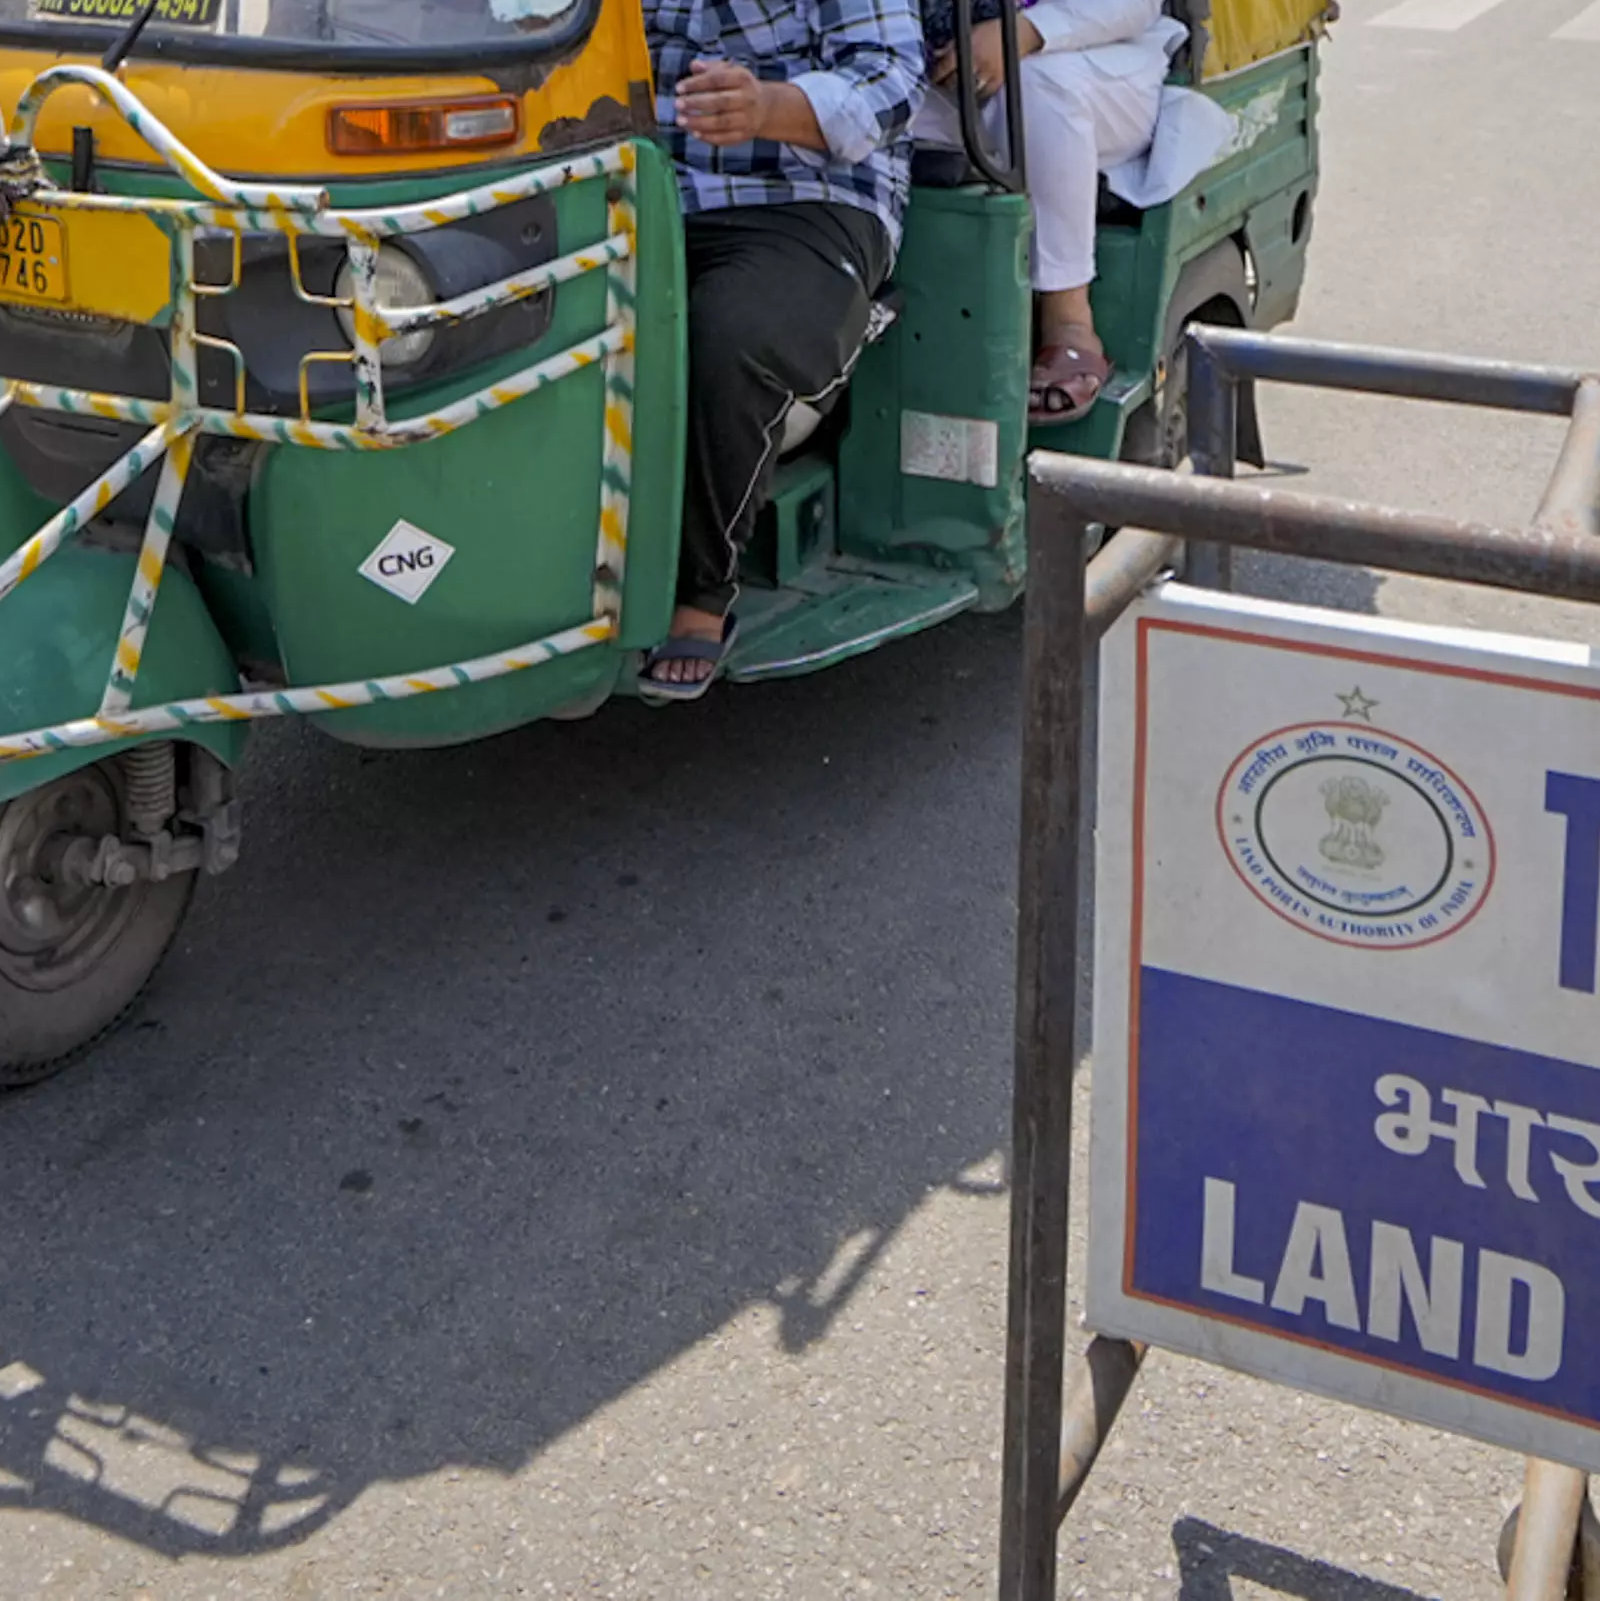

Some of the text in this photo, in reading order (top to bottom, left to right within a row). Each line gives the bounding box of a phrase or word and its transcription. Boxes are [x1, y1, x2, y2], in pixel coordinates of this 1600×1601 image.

[377, 545, 434, 577] CNG
[1234, 836, 1475, 938] LAND PORTS AUTHORITY OF INDIA
[1201, 1175, 1566, 1382] LAND
